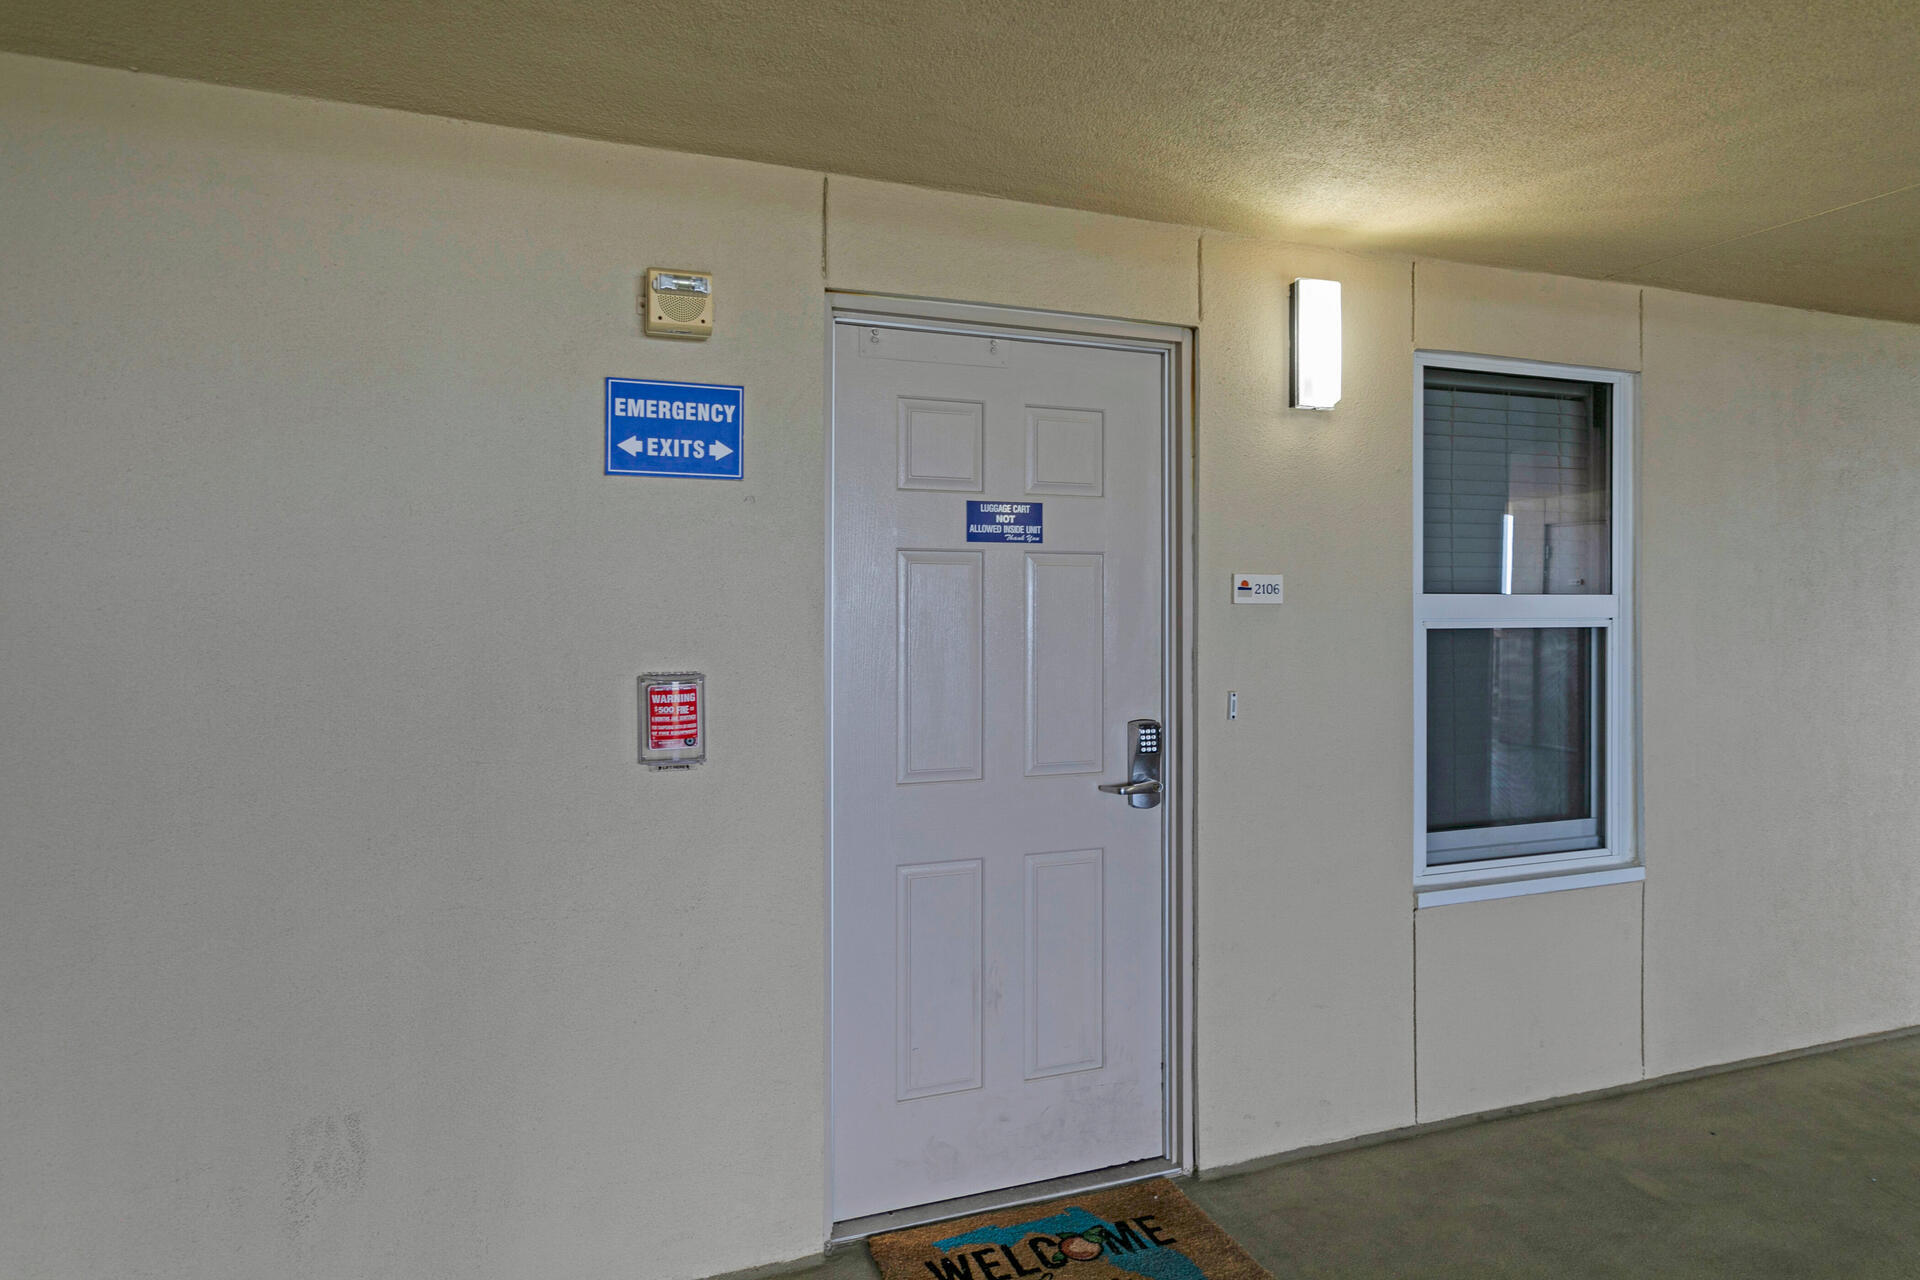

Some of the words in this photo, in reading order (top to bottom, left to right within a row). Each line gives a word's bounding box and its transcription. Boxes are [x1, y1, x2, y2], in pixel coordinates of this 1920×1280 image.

[614, 397, 736, 423] EMERGENCY
[647, 437, 705, 459] EXITS
[980, 504, 1011, 512] LUGGAGE
[1012, 505, 1030, 513] CART
[995, 515, 1015, 523] NOT
[969, 524, 1001, 533] ALLOWED
[1004, 525, 1024, 533] INSIDE
[1254, 583, 1280, 595] 2106
[651, 693, 696, 704] WARNING
[924, 1214, 1177, 1280] WELCOME
